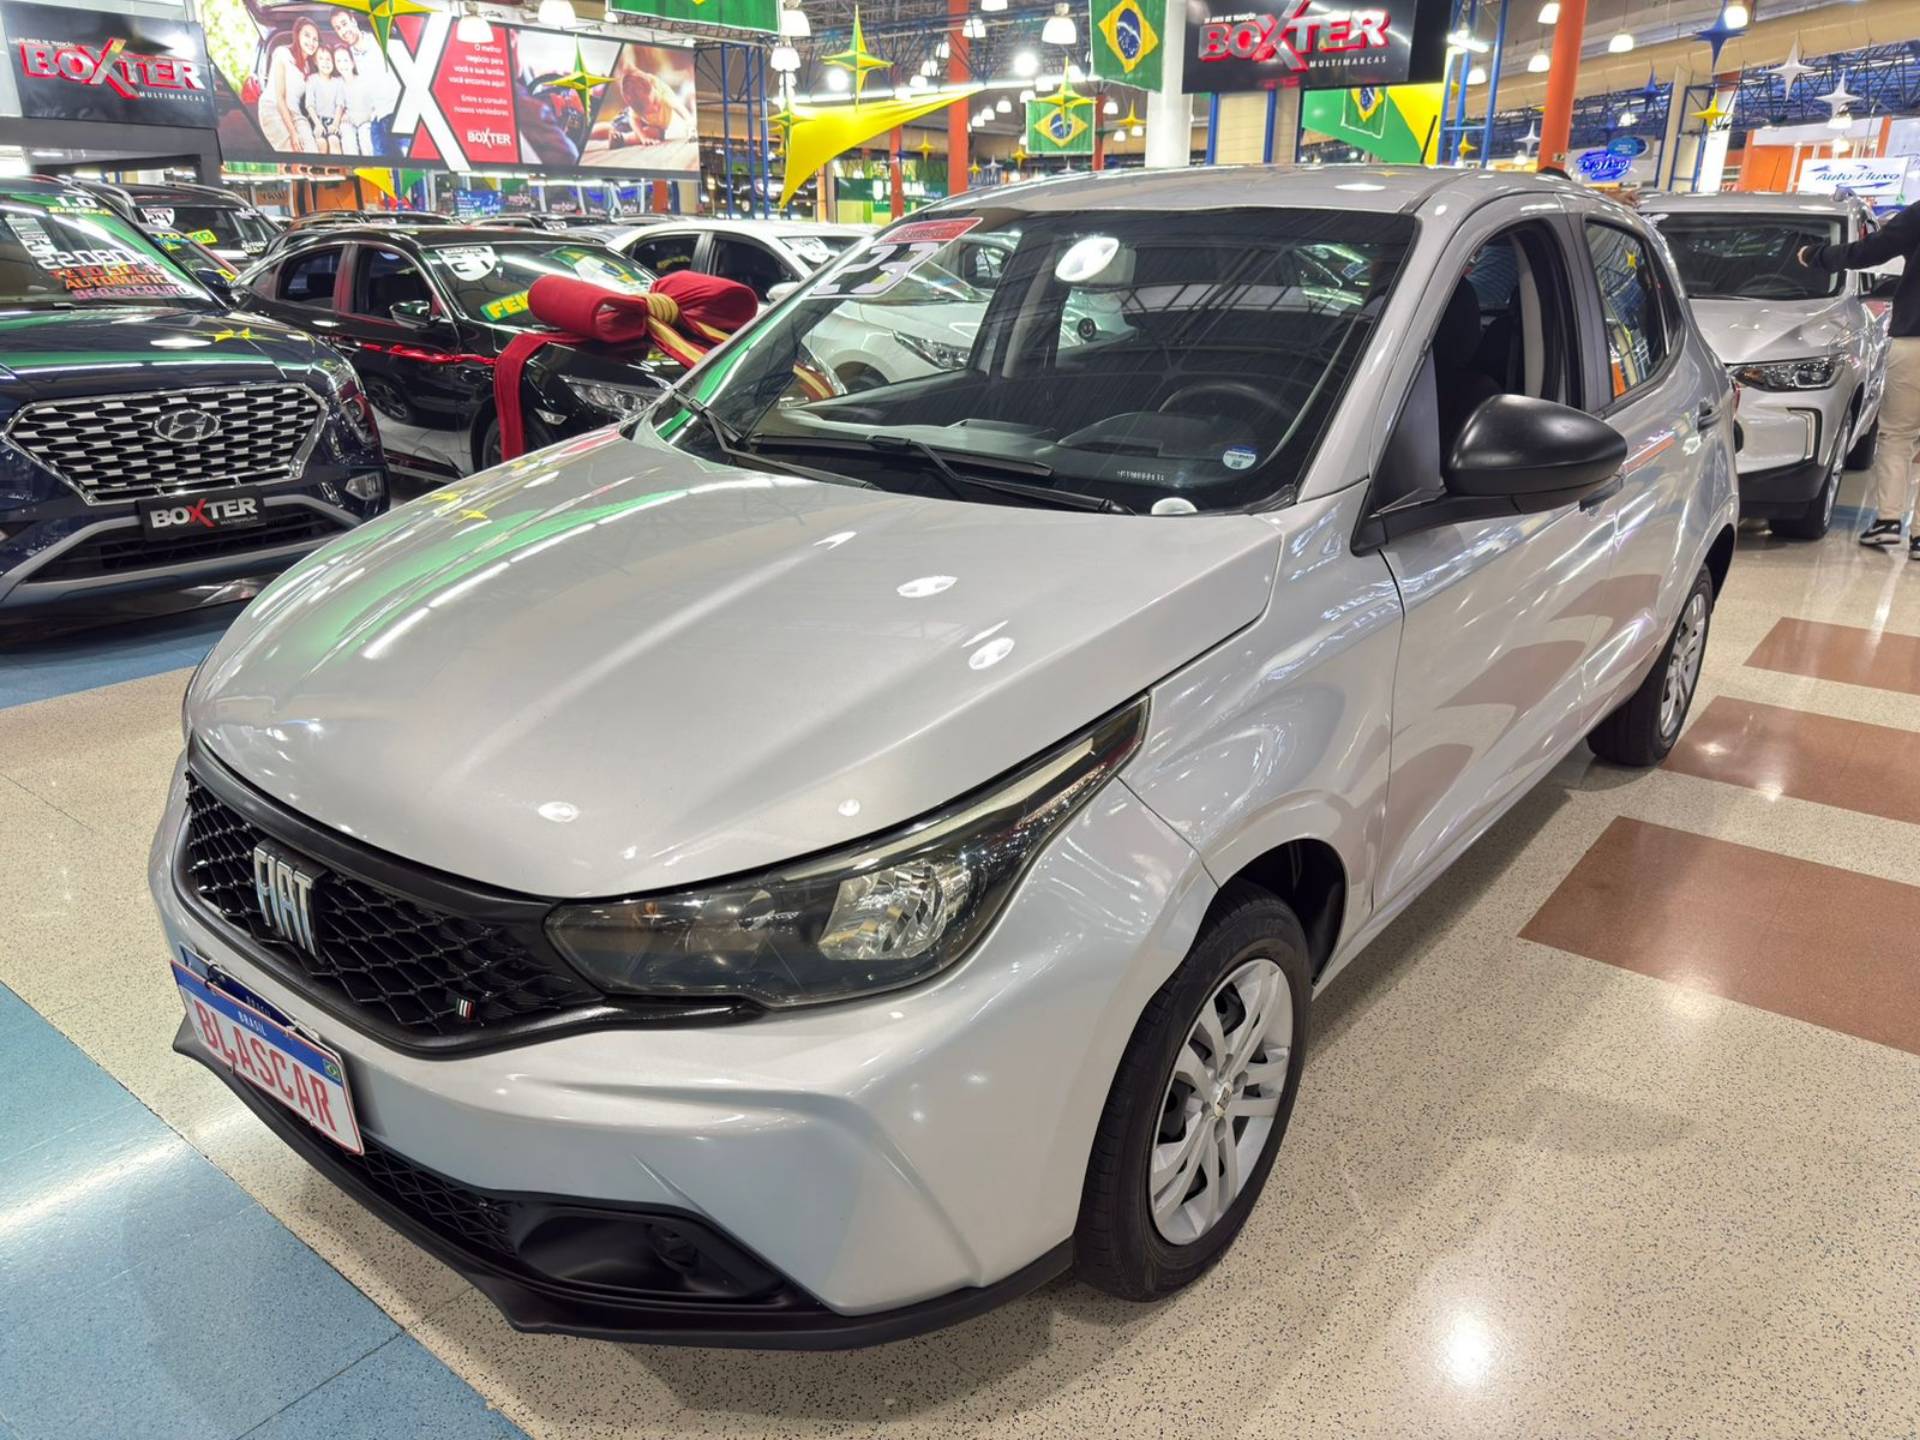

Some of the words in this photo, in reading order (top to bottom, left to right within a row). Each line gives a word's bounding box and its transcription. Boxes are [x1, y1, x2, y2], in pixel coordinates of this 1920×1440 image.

[1198, 0, 1392, 72] BOXTER
[19, 37, 206, 98] BOXTER
[1309, 55, 1387, 68] MULTIMARCAS
[138, 90, 206, 103] MULTIMARCAS
[466, 127, 512, 149] BOXTER
[1815, 171, 1852, 181] Auto
[811, 242, 940, 296] 23
[149, 497, 259, 529] BOXTER
[254, 847, 315, 957] FIAT
[238, 1010, 268, 1037] BRASIL
[194, 999, 338, 1133] BLASCAR
